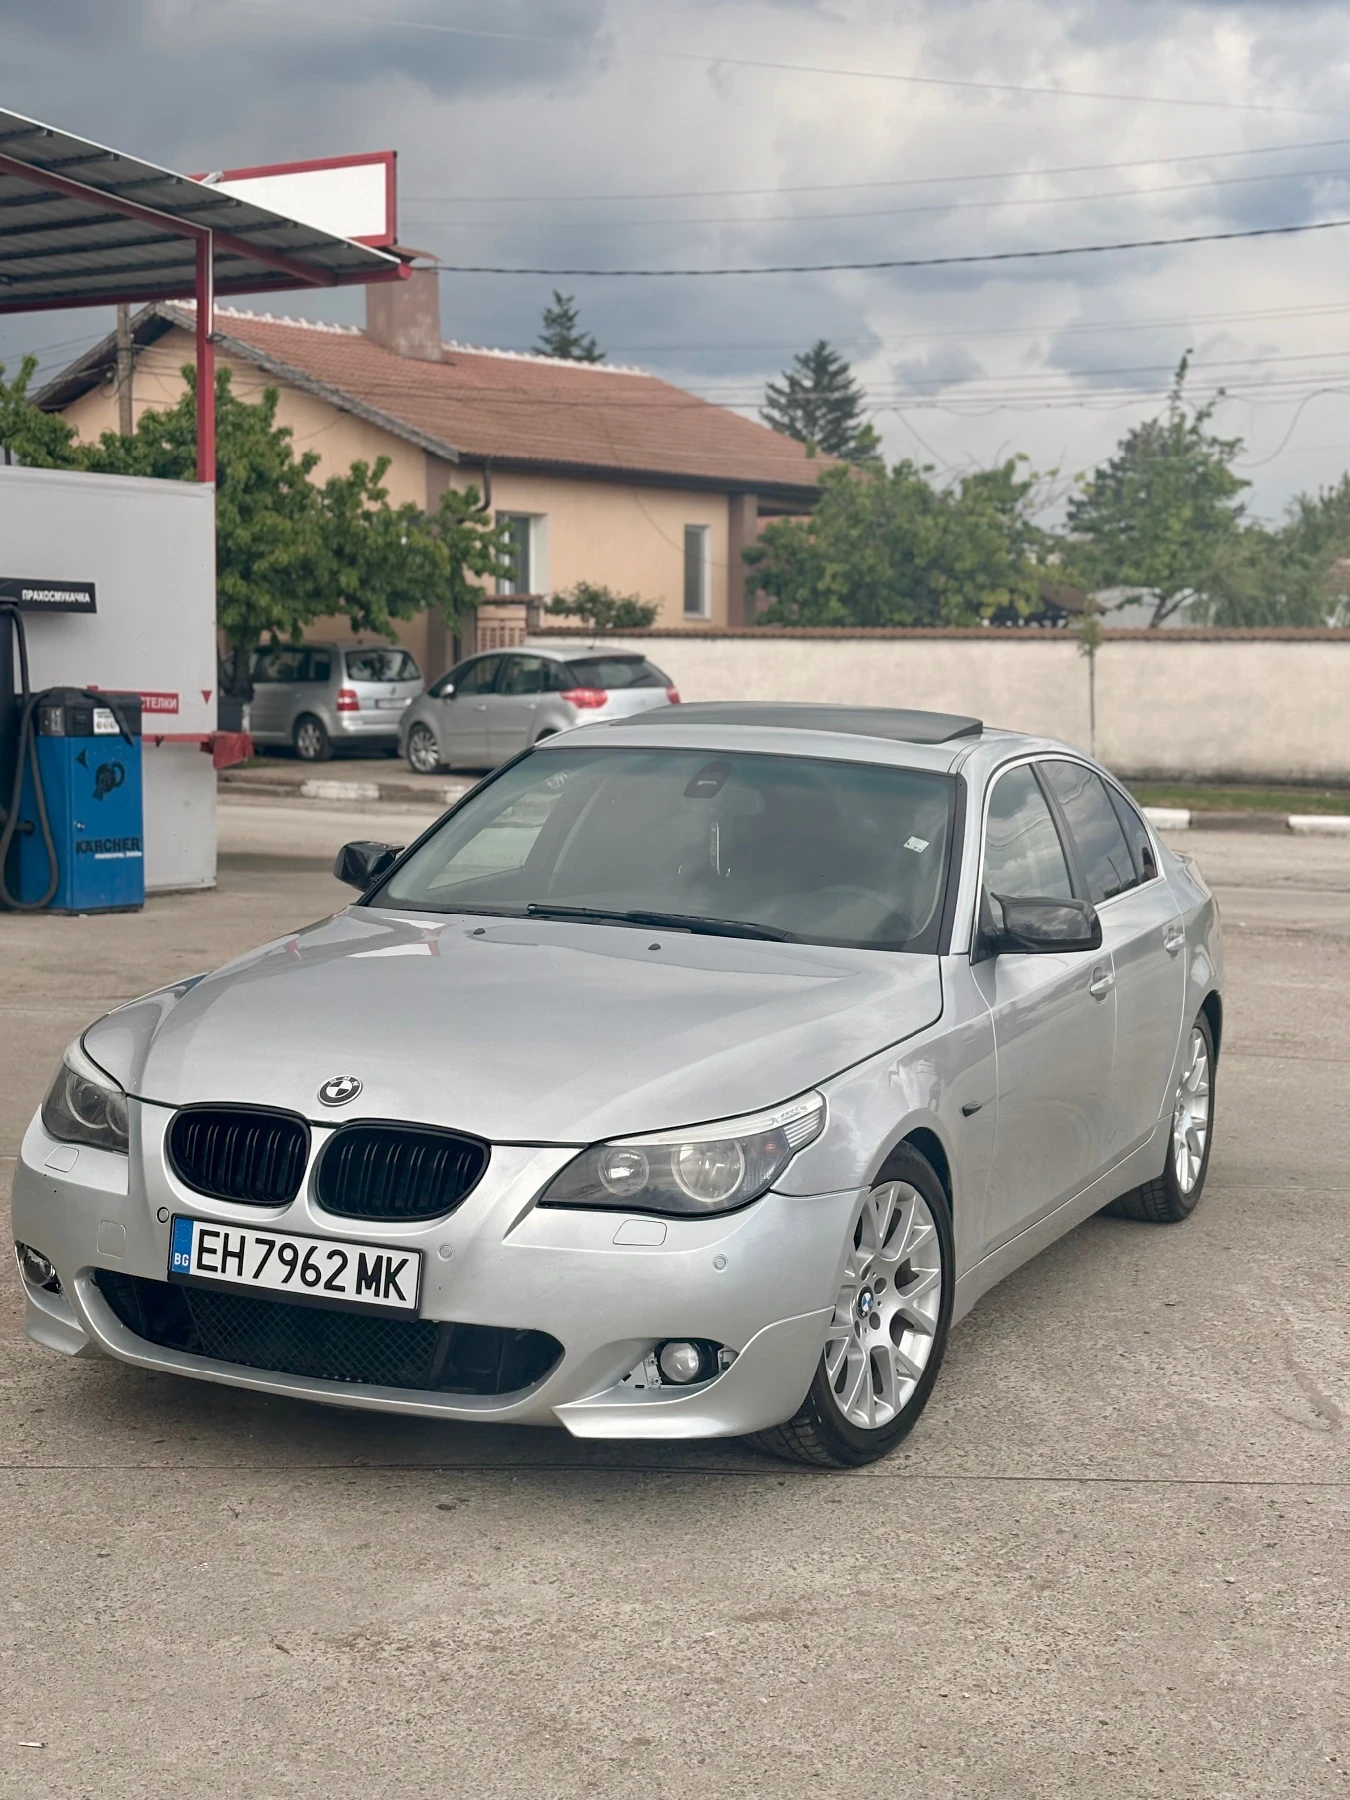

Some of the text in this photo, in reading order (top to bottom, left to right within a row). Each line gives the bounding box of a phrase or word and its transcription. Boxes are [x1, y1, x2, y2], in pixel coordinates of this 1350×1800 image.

[21, 588, 91, 604] ПРАХОСМУКАЧКА
[174, 1252, 190, 1267] BG
[196, 1228, 410, 1302] EH 7962 MK
